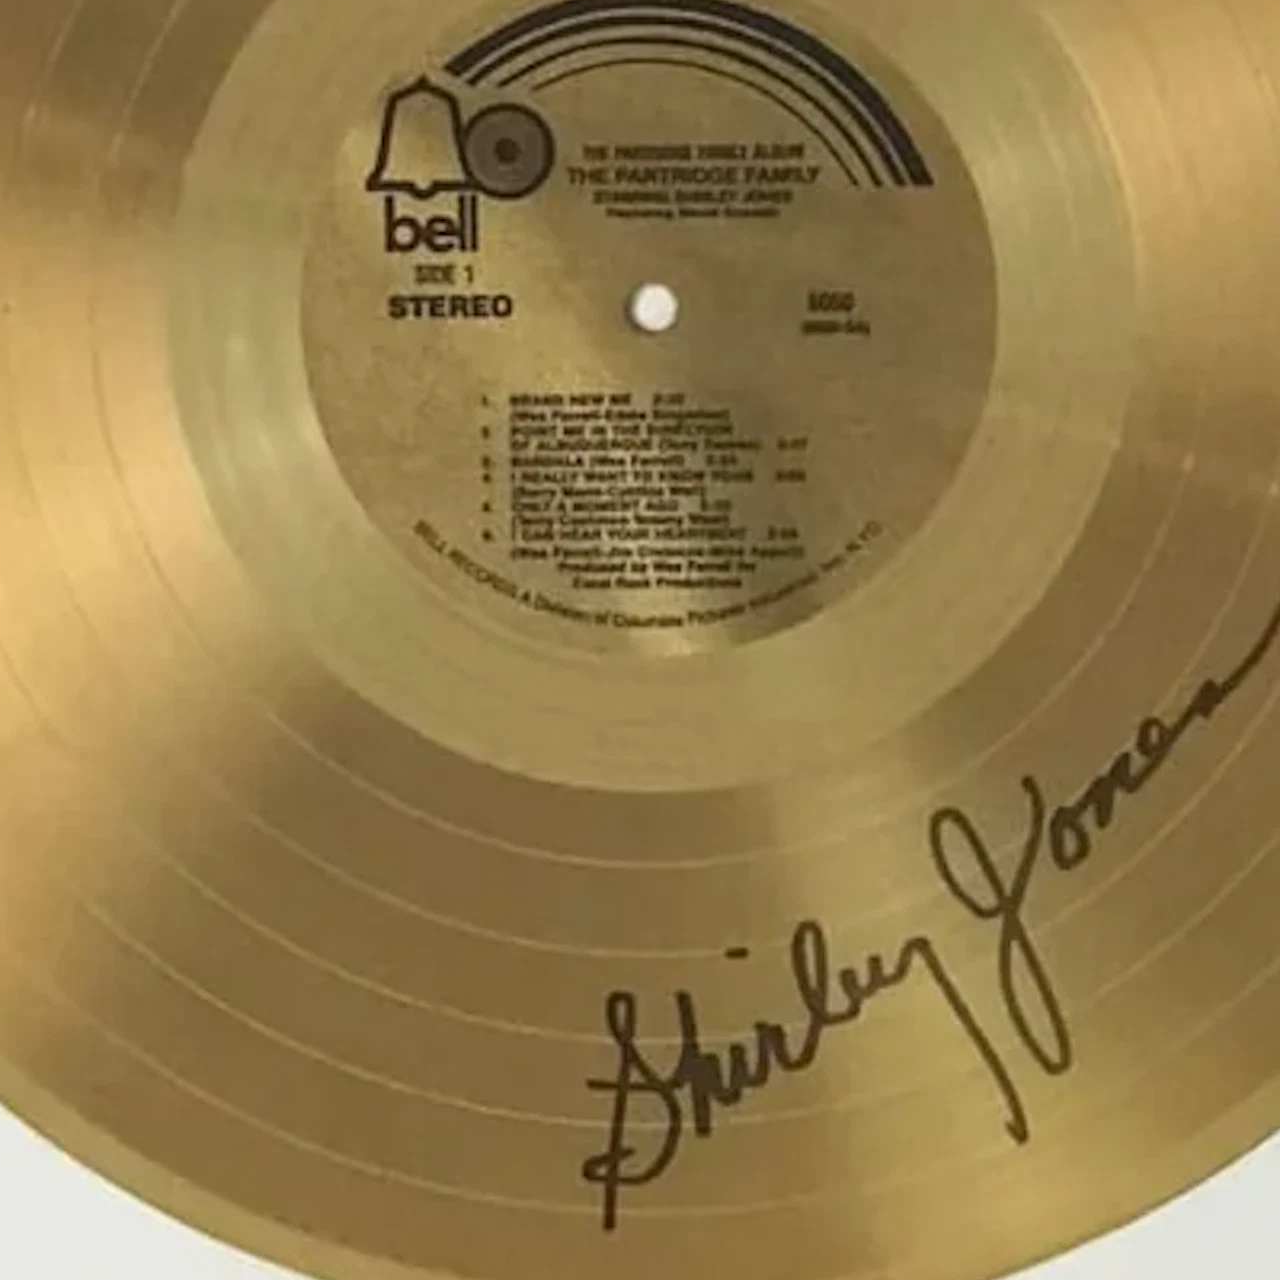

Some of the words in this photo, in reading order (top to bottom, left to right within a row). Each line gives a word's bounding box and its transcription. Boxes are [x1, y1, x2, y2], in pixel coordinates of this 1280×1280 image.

[567, 166, 610, 185] THE
[742, 166, 821, 185] FAMILY
[385, 195, 477, 252] bell
[415, 264, 455, 285] SIDE
[464, 264, 474, 285] 1
[388, 294, 513, 318] STEREO
[581, 920, 1029, 1233] Shirley
